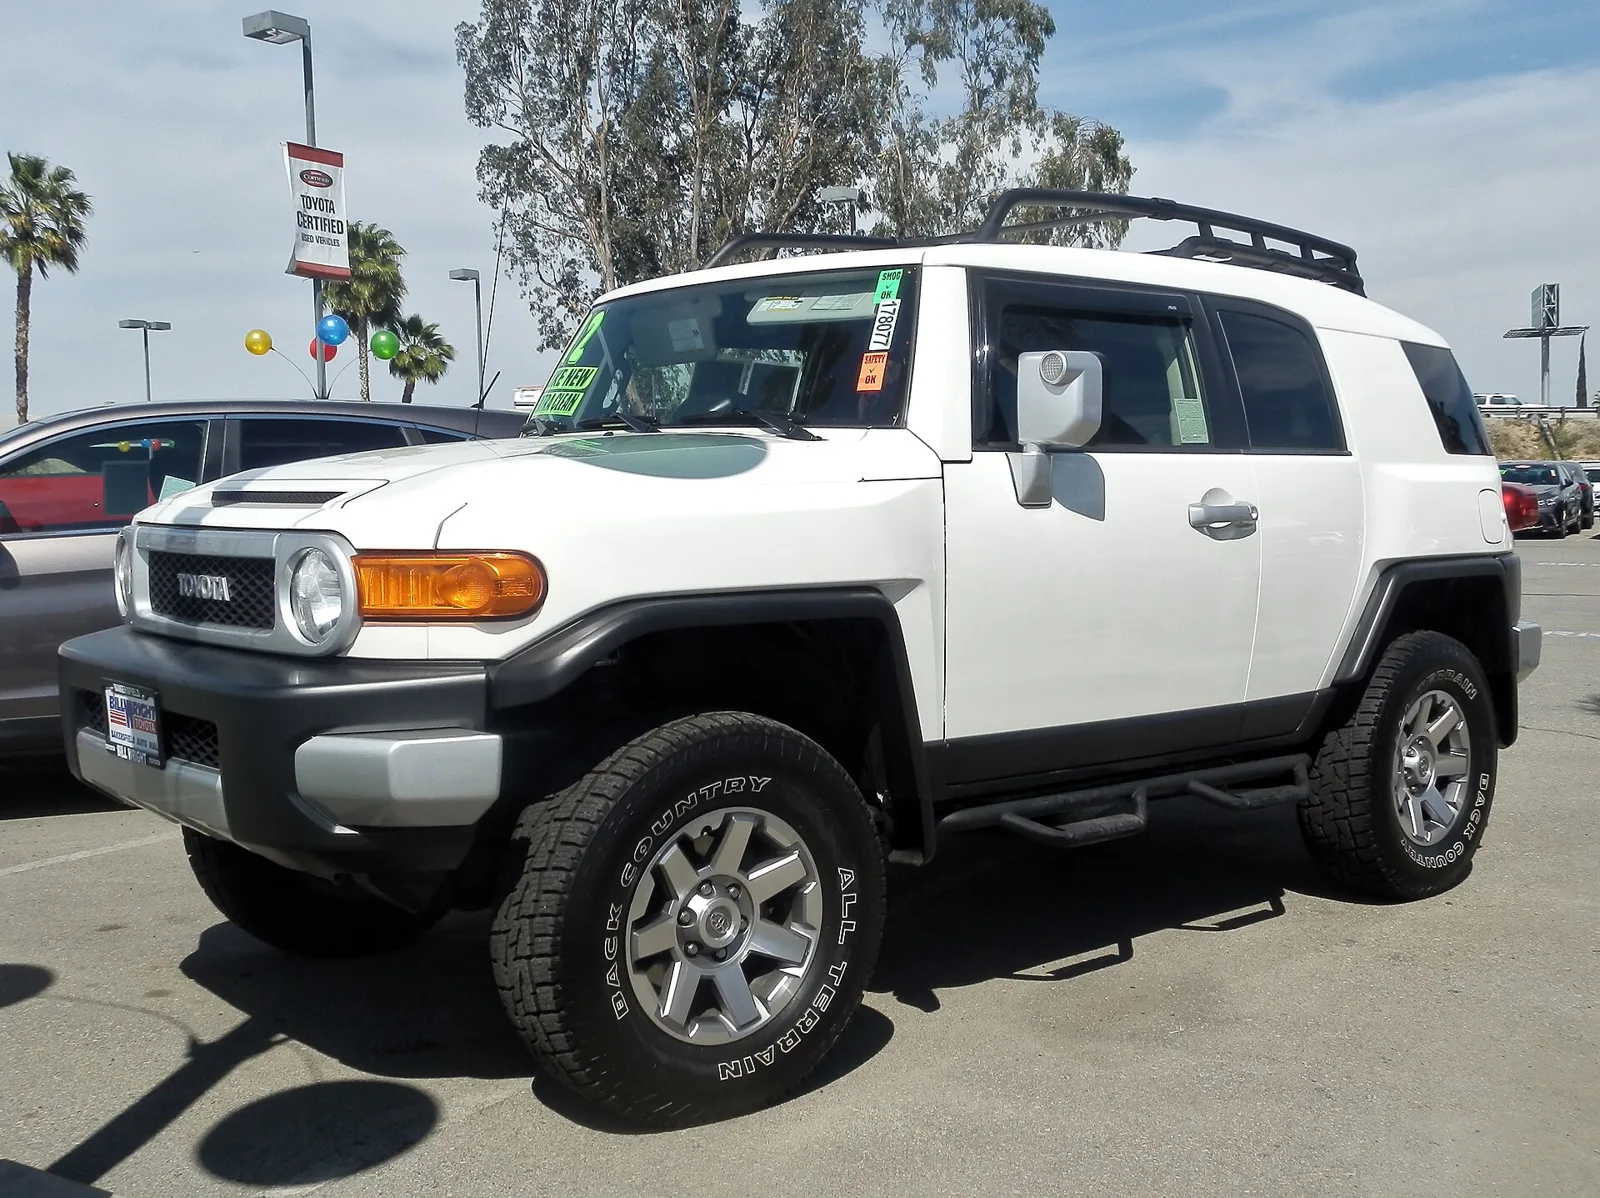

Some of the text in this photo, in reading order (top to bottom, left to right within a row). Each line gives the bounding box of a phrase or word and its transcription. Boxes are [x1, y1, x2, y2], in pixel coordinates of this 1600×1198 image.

[300, 194, 336, 214] TOYOTA
[297, 211, 344, 234] CERTIFIED
[301, 232, 340, 247] USED VEHICLES
[882, 271, 901, 281] SMOG
[880, 290, 892, 299] OK
[873, 301, 897, 346] 178077
[864, 354, 886, 365] SAFETY
[561, 367, 595, 387] NEW
[864, 375, 877, 385] OK
[550, 392, 581, 412] CLEAN
[177, 573, 231, 602] TOYOTA
[134, 718, 156, 733] TOYOTA
[1400, 773, 1489, 869] BACK COUNTRY
[604, 775, 771, 1021] BACK COUNTRY
[718, 866, 857, 1081] ALL TERRAIN
